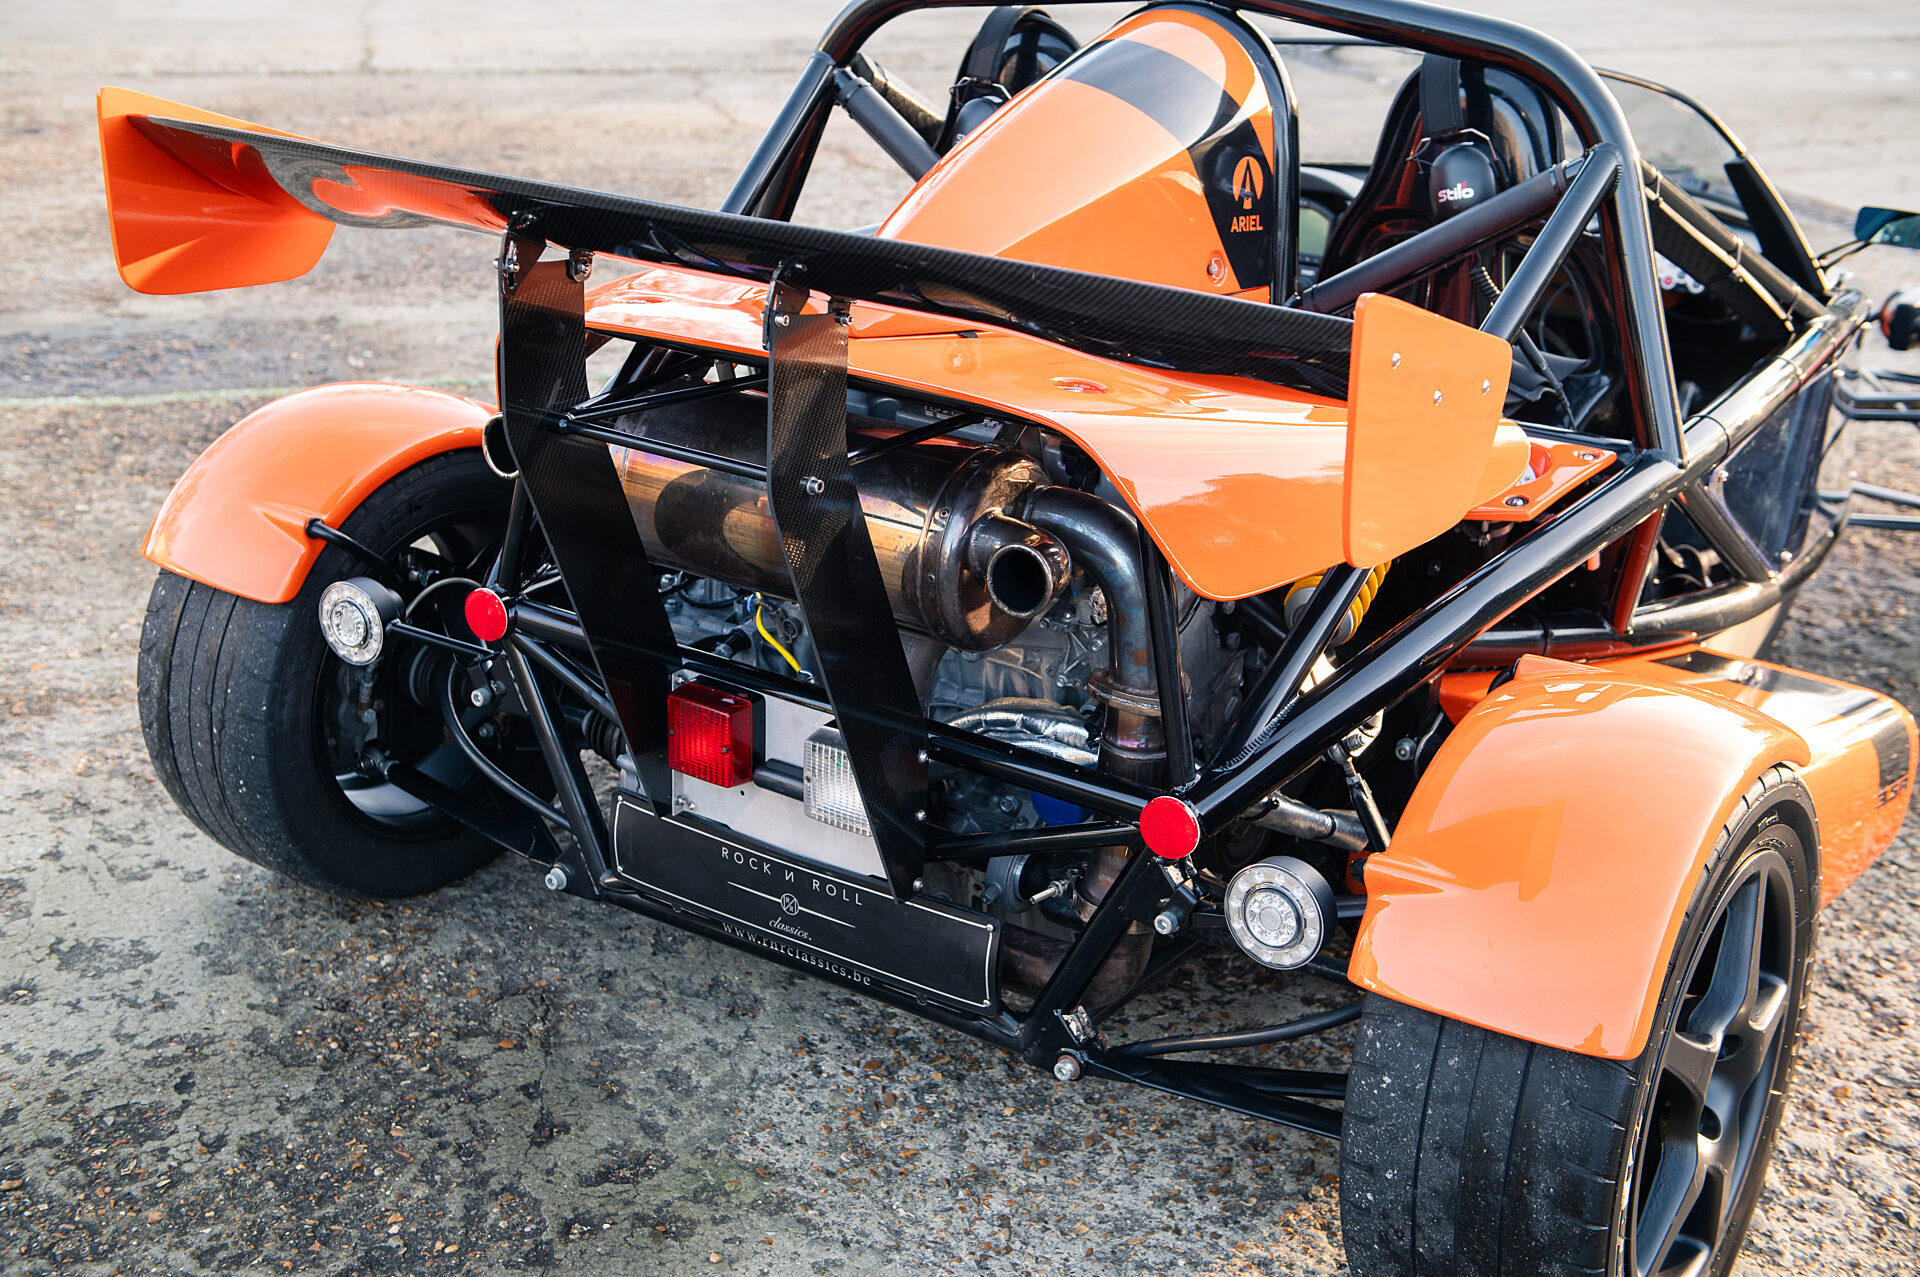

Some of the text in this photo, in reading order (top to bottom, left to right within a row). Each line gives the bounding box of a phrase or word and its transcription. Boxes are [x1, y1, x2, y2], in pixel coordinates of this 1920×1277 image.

[1438, 181, 1475, 203] stilo
[1230, 214, 1264, 233] ARIEL
[721, 846, 772, 875] ROCK
[812, 879, 863, 906] ROLL
[768, 916, 813, 941] classics.
[722, 922, 872, 986] www.rnrclassics.be
